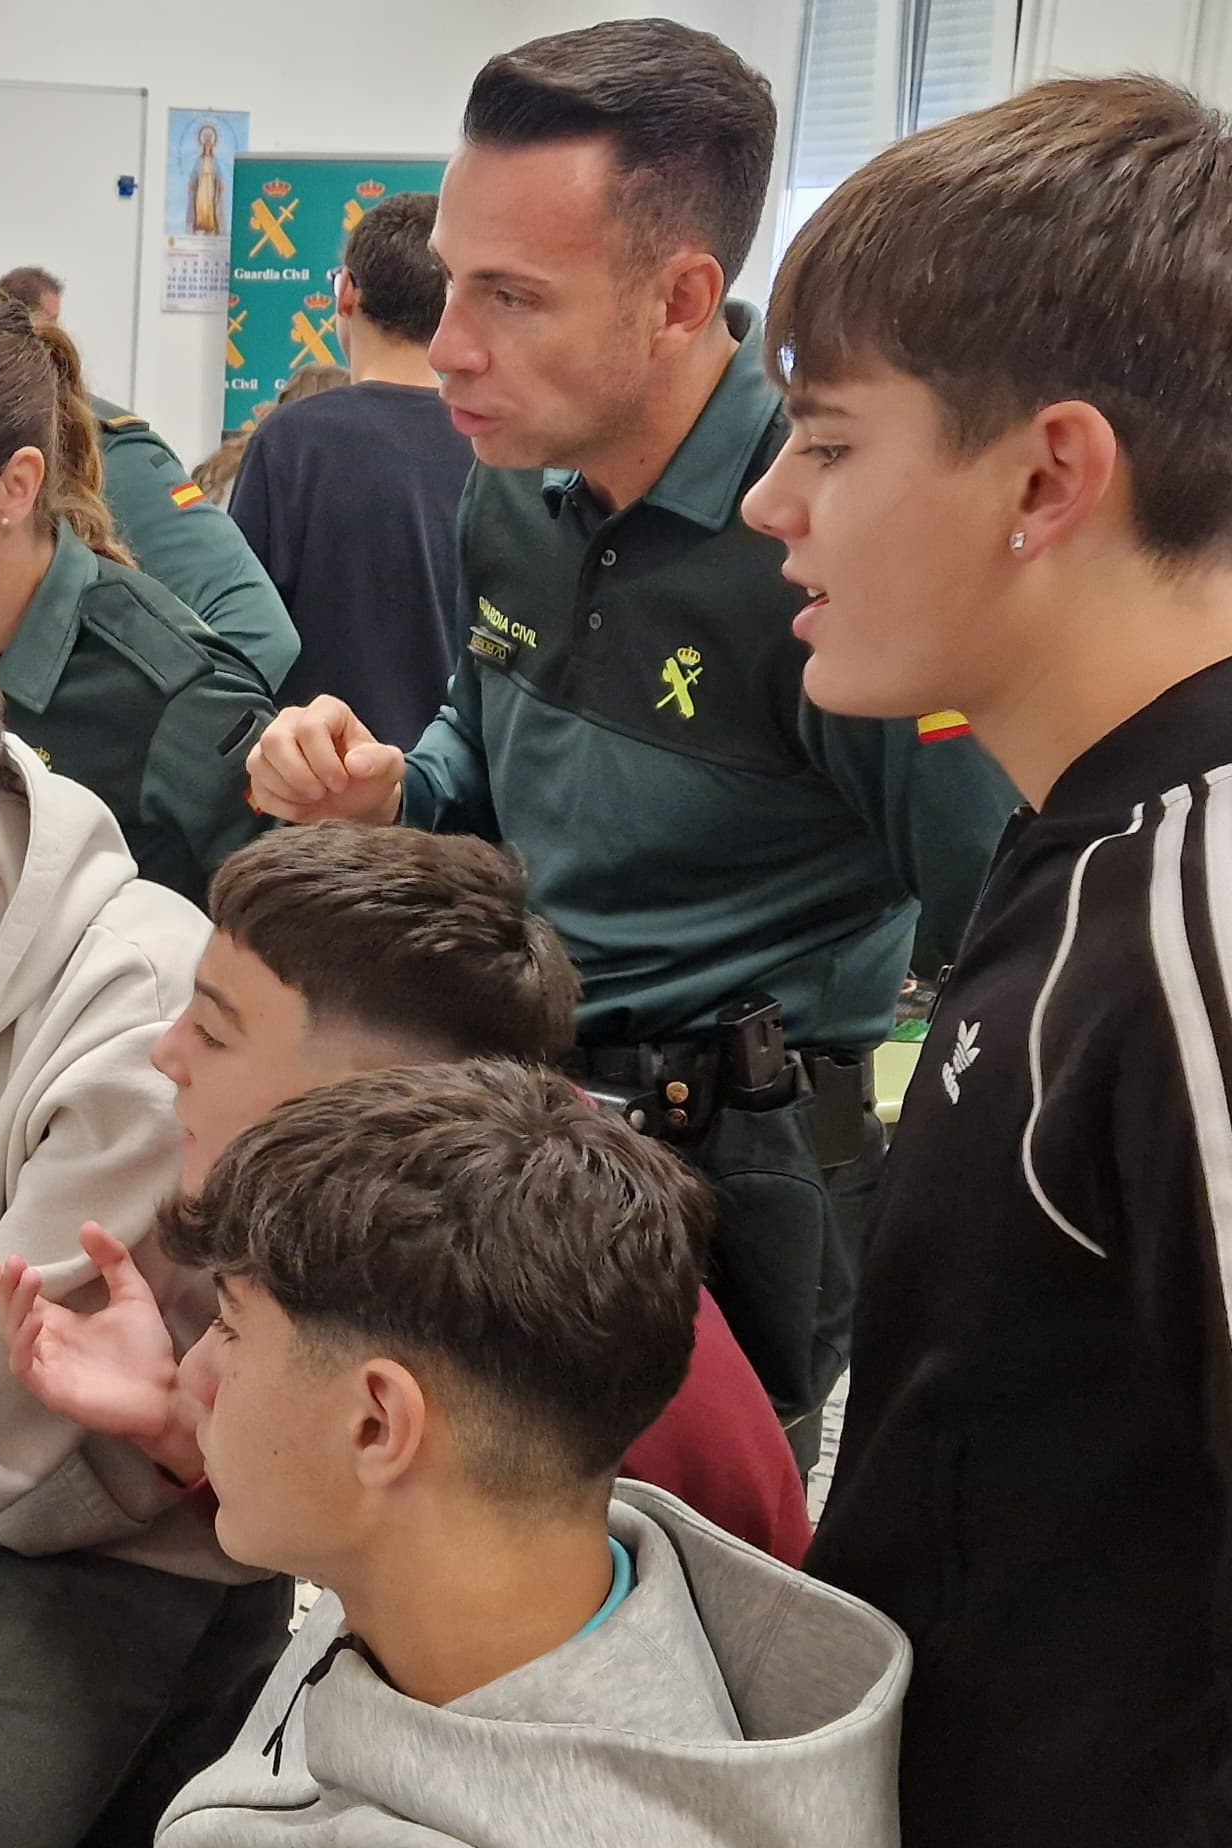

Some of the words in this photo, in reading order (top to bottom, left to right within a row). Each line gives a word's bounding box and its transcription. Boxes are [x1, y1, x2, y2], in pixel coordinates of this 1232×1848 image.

[234, 268, 280, 280] Guardia
[282, 268, 309, 280] Civil
[231, 378, 258, 390] Civil
[479, 596, 508, 633] GUARDIA
[511, 623, 537, 648] CIVIL
